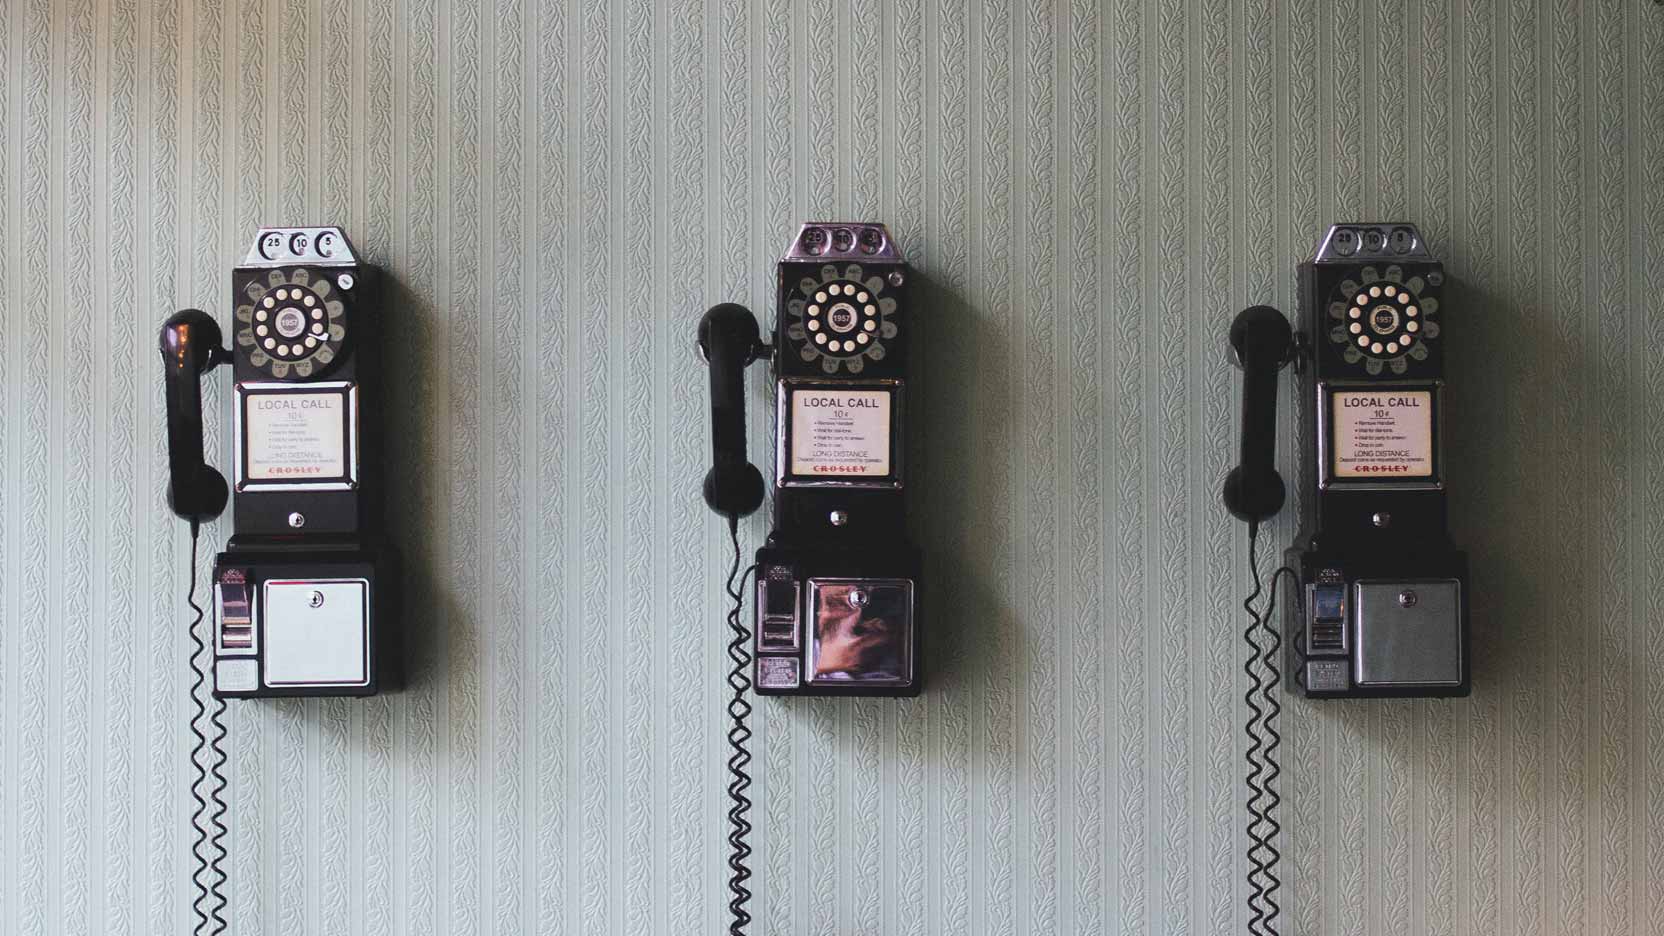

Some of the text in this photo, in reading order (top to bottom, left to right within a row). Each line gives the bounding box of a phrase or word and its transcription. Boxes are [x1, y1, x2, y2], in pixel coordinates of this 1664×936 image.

[268, 237, 332, 247] 25 10 5
[808, 232, 821, 242] 25
[1338, 233, 1350, 243] 25
[1368, 234, 1378, 244] 10
[833, 314, 850, 322] 1957
[1376, 316, 1393, 324] 1957
[258, 399, 332, 410] LOCAL CALL
[804, 398, 880, 408] LOCAL CALL
[1344, 398, 1420, 407] LOCAL CALL
